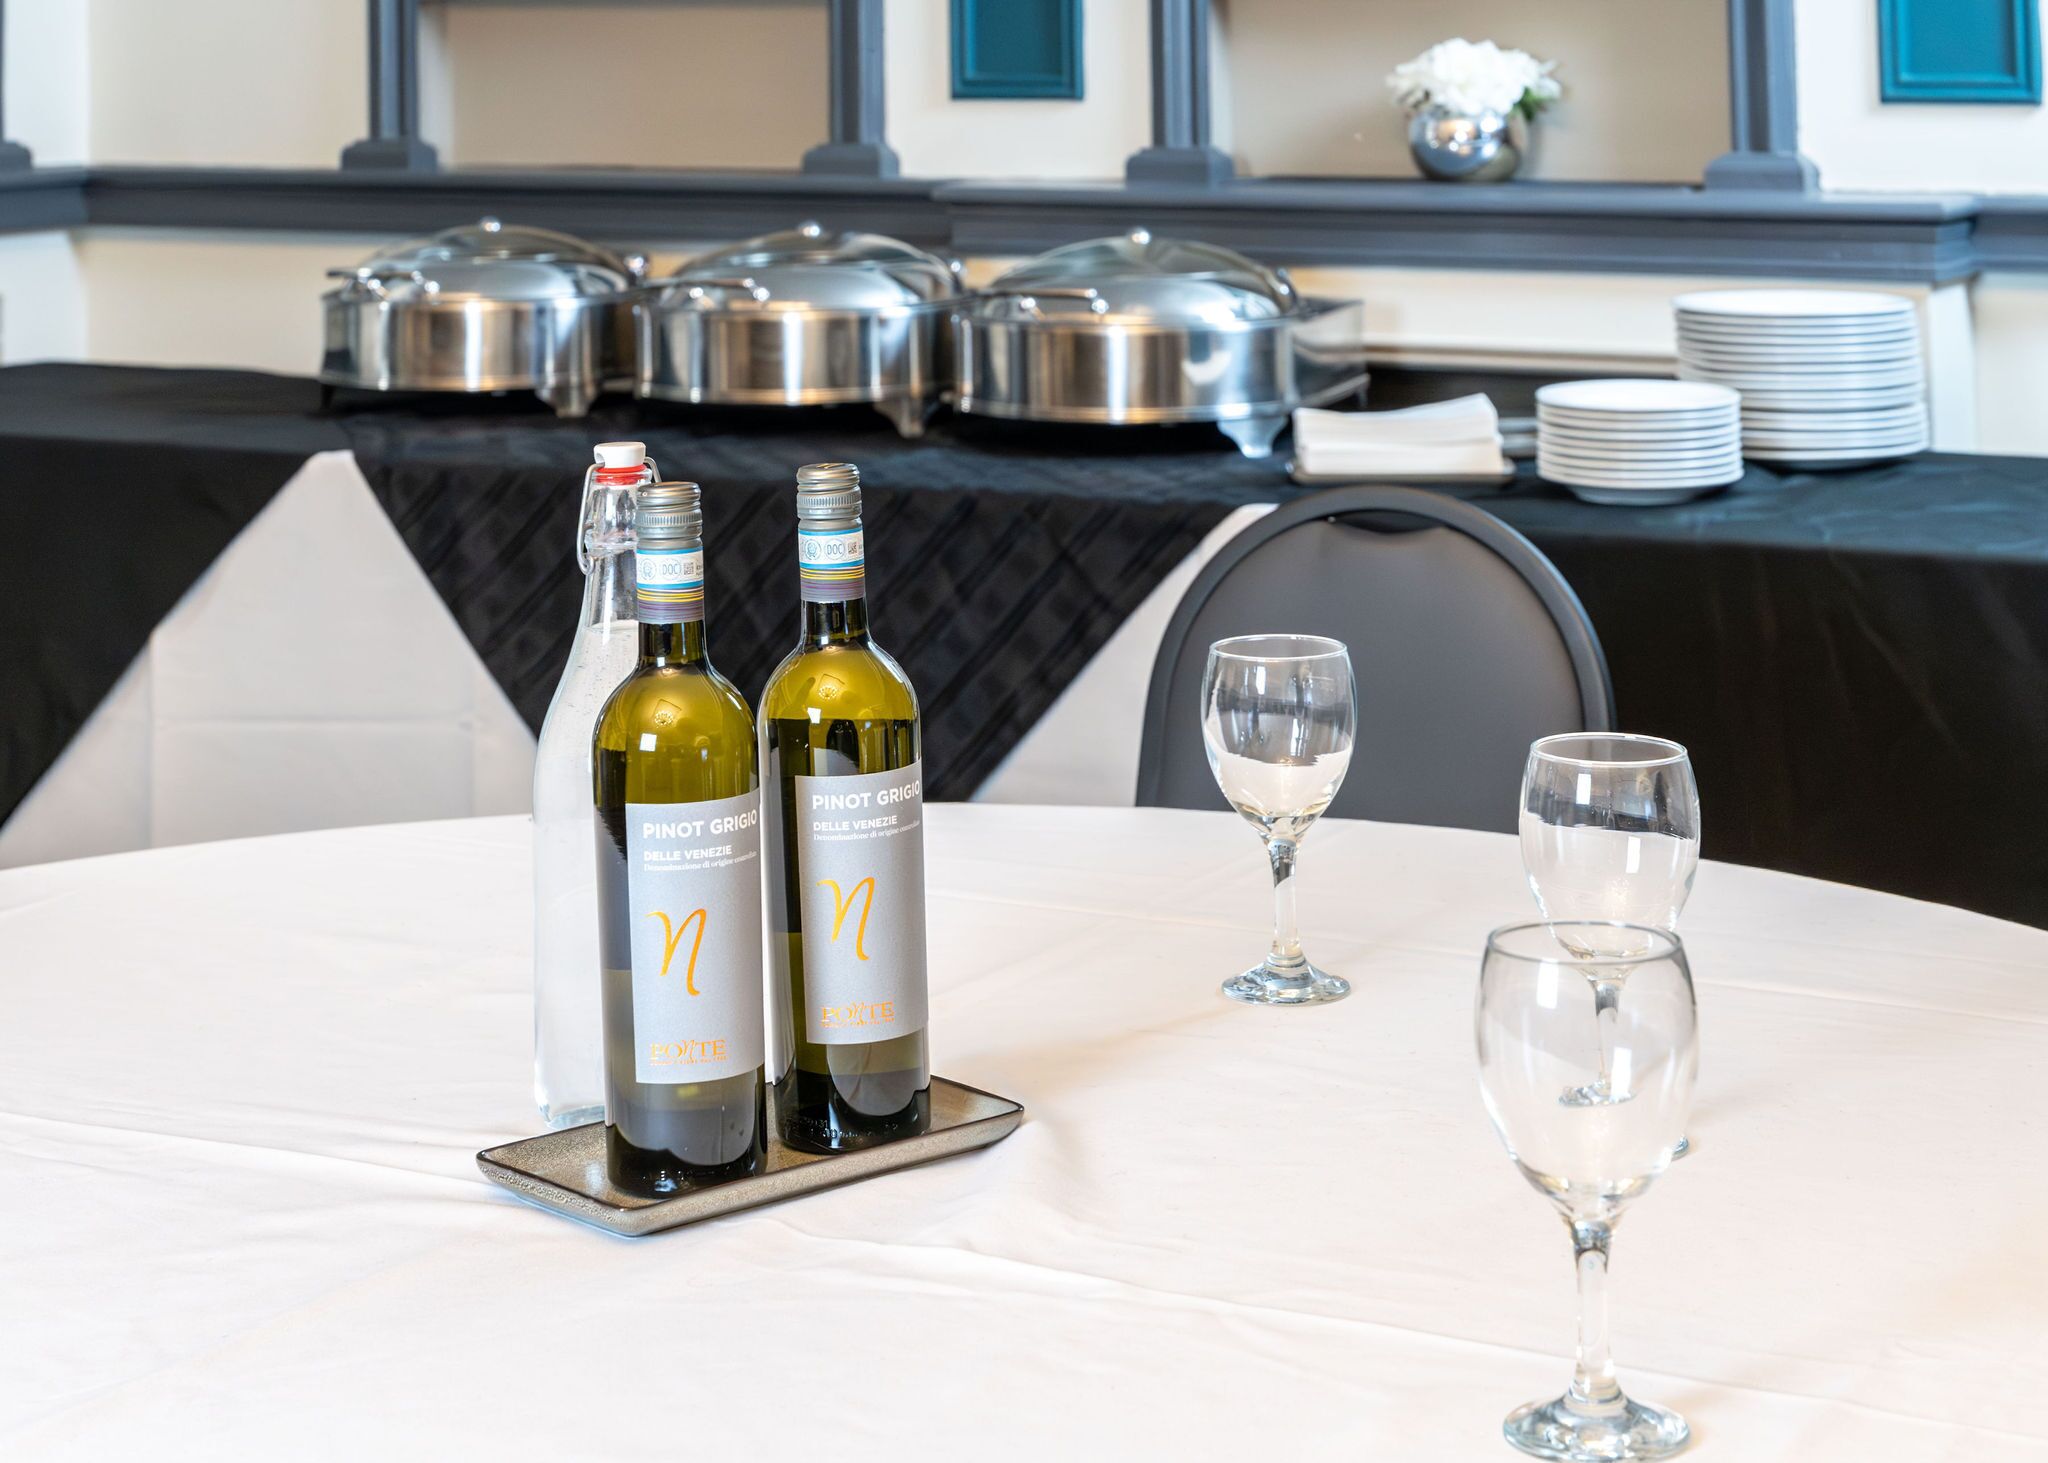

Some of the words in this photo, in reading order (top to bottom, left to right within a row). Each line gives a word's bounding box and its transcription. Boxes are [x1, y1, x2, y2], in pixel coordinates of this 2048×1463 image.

[812, 792, 872, 810] PINOT
[876, 780, 920, 806] GRIGIO
[642, 820, 705, 839] PINOT
[710, 809, 758, 835] GRIGIO
[813, 821, 850, 831] DELLE
[852, 815, 898, 830] VENEZIE
[869, 830, 877, 838] di
[643, 850, 681, 862] DELLE
[684, 845, 733, 860] VENEZIE
